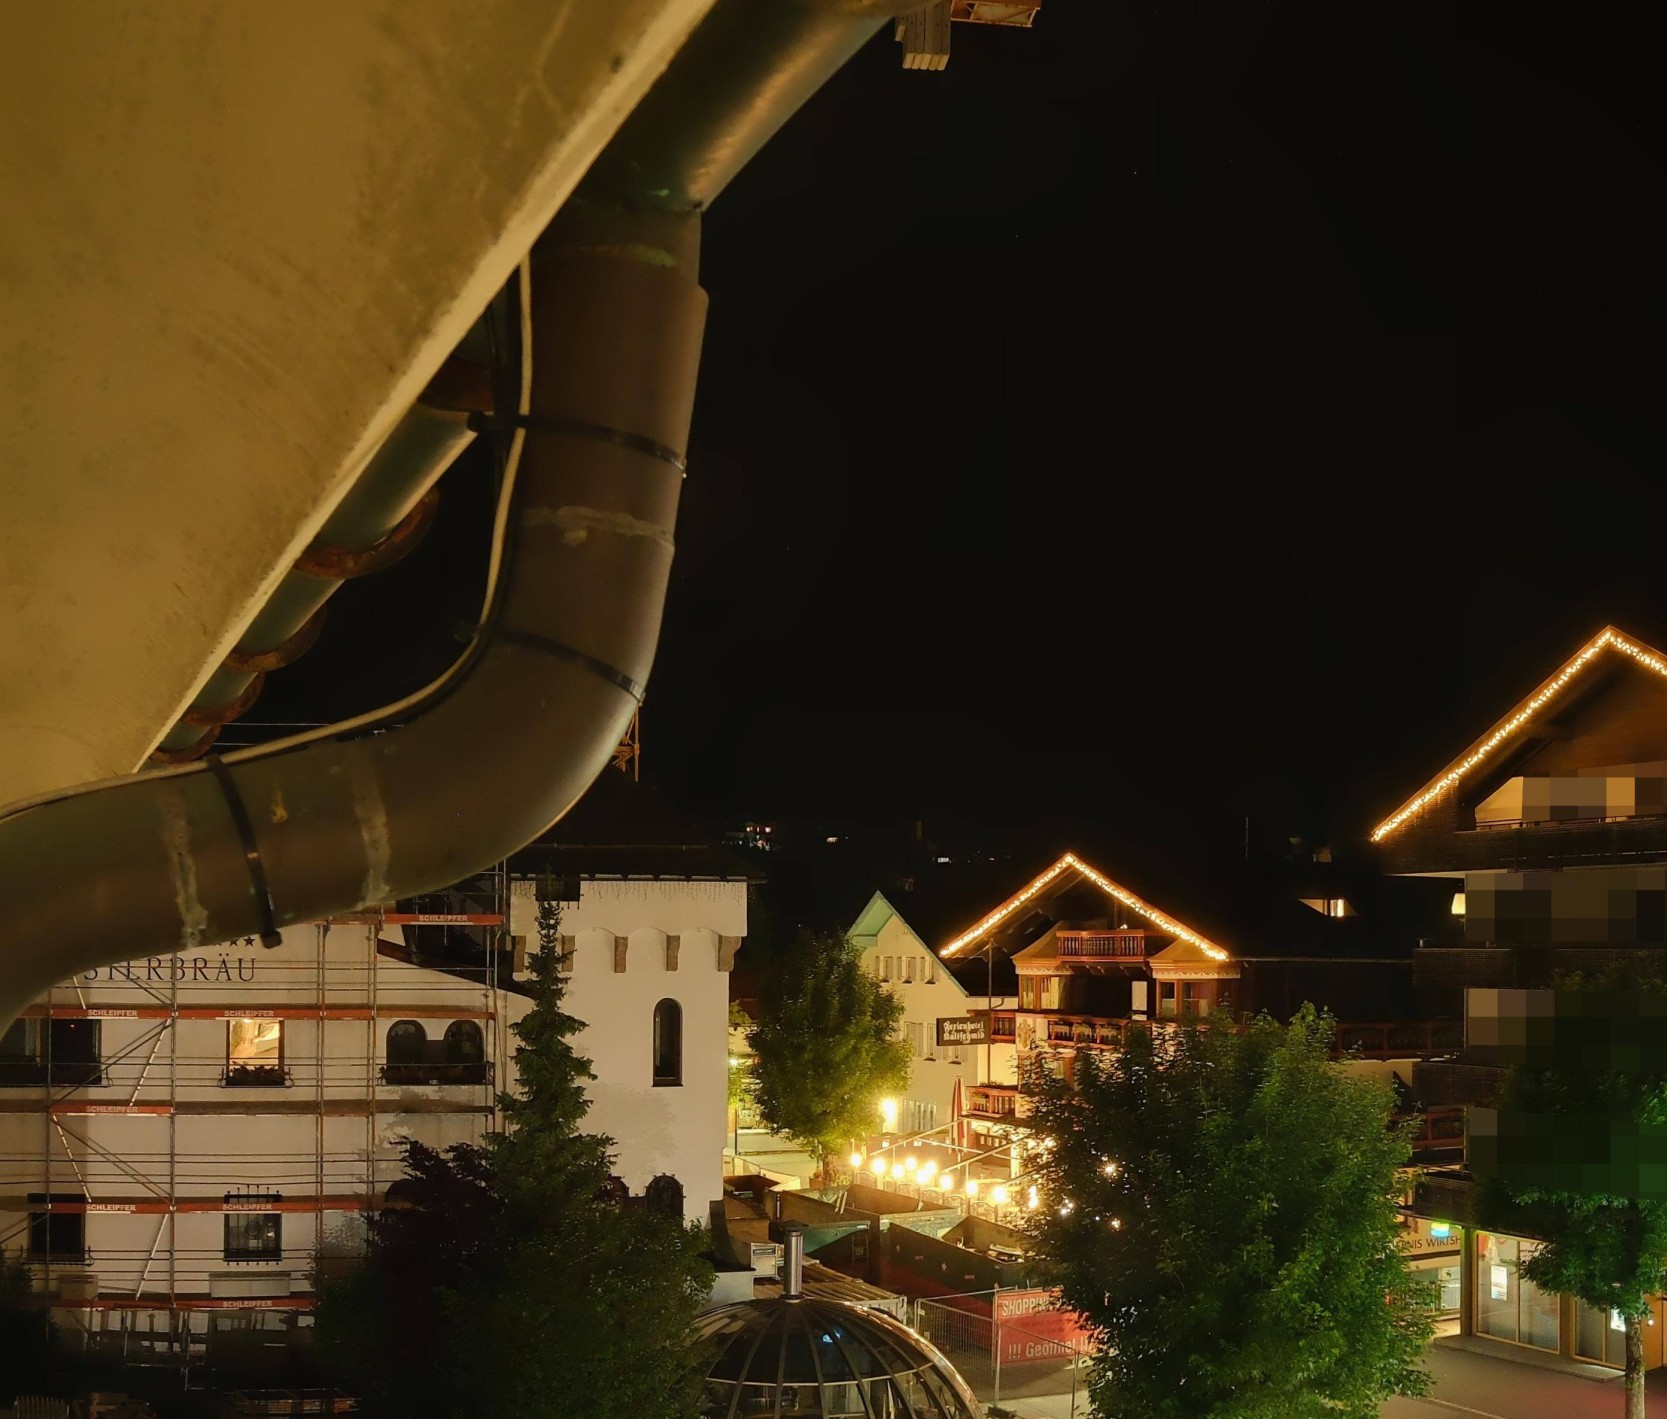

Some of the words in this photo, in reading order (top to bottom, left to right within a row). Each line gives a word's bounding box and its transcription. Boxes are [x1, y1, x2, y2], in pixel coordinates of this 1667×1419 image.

[418, 914, 469, 922] SCHLEIPFER
[87, 1009, 138, 1017] SCHLEIPFER
[224, 1009, 275, 1018] SCHLEIPFER
[85, 1105, 138, 1114] SCHLEIPFER
[85, 1203, 136, 1211] SCHLEIPFER
[222, 1202, 273, 1211] SCHLEIPFER
[222, 1300, 273, 1308] SCHLEIPFER
